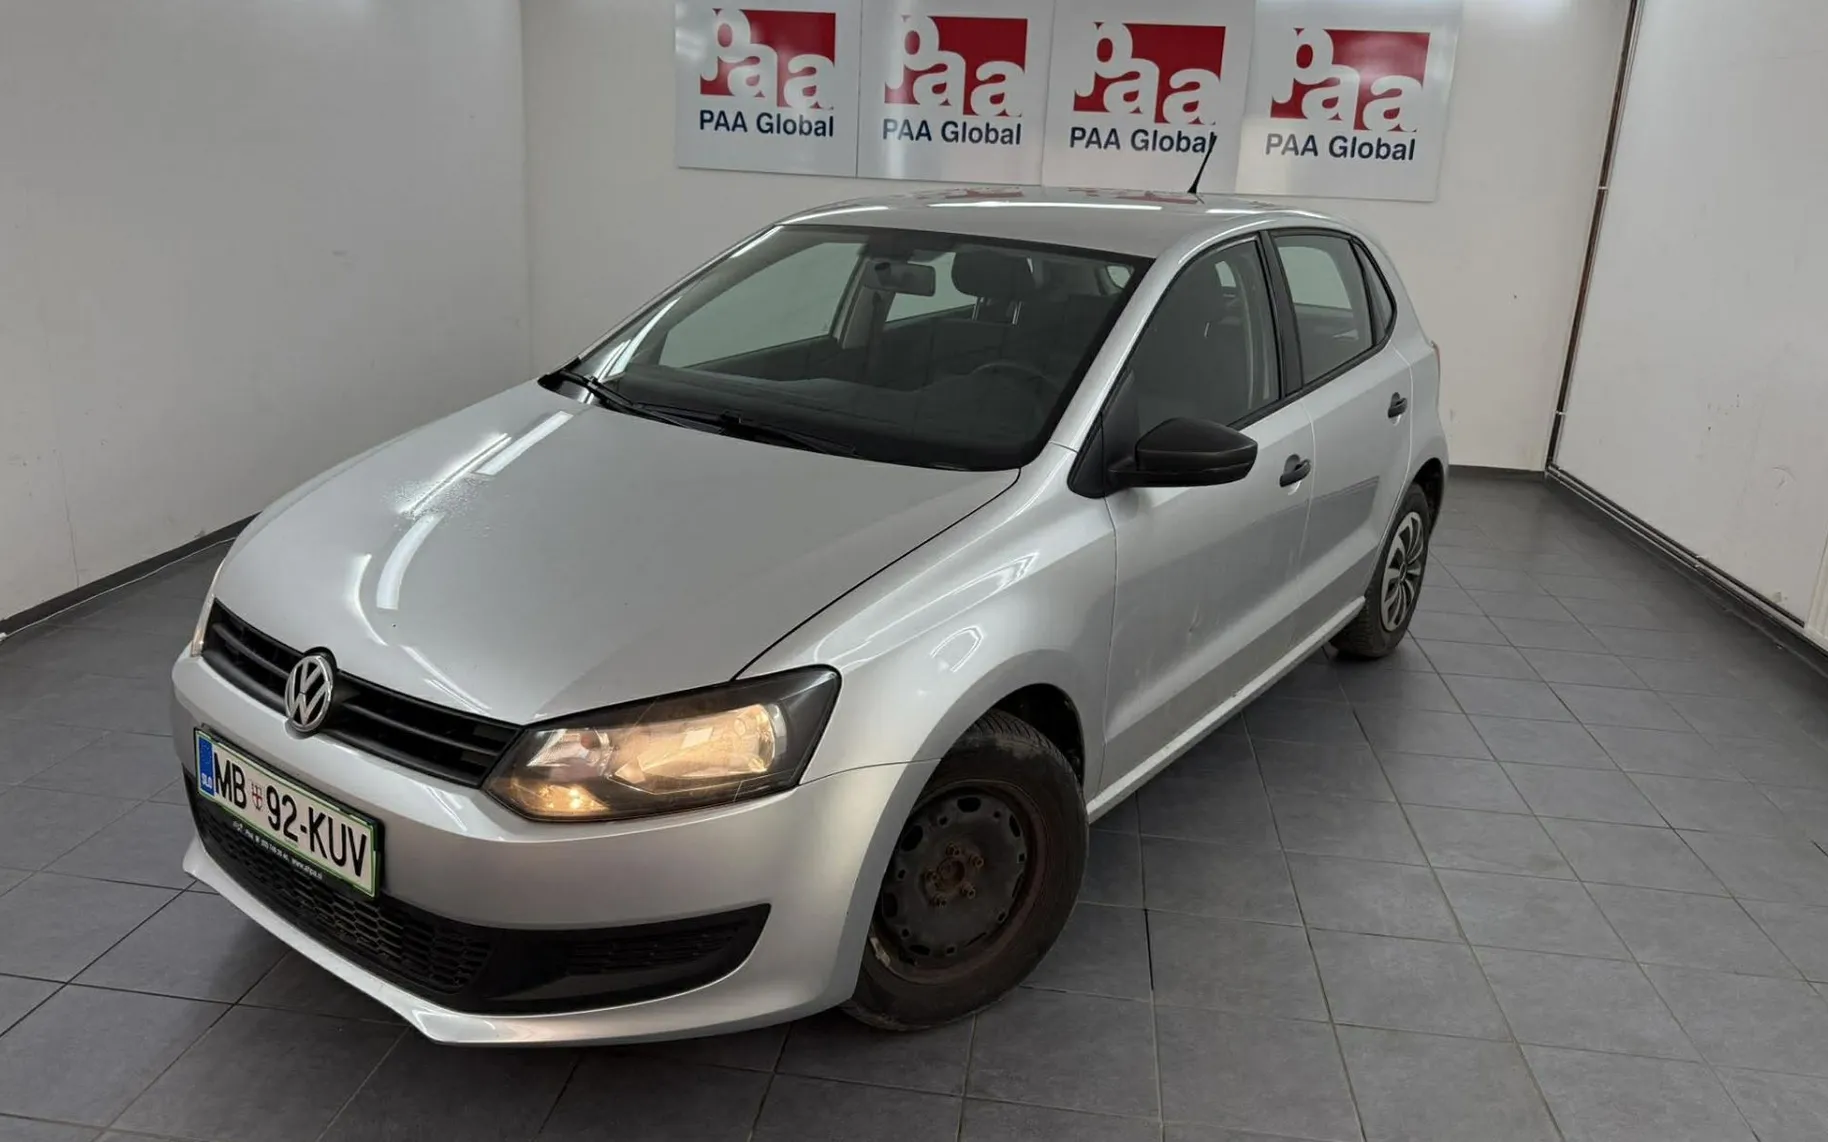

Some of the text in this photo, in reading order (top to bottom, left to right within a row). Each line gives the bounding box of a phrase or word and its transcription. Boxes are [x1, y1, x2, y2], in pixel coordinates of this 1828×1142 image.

[699, 109, 834, 138] PAA Global
[882, 118, 1022, 145] PAA Global
[1069, 126, 1215, 154] PAA Global
[1265, 133, 1416, 161] PAA Global
[214, 752, 247, 810] MB
[266, 785, 367, 877] 92-KUV
